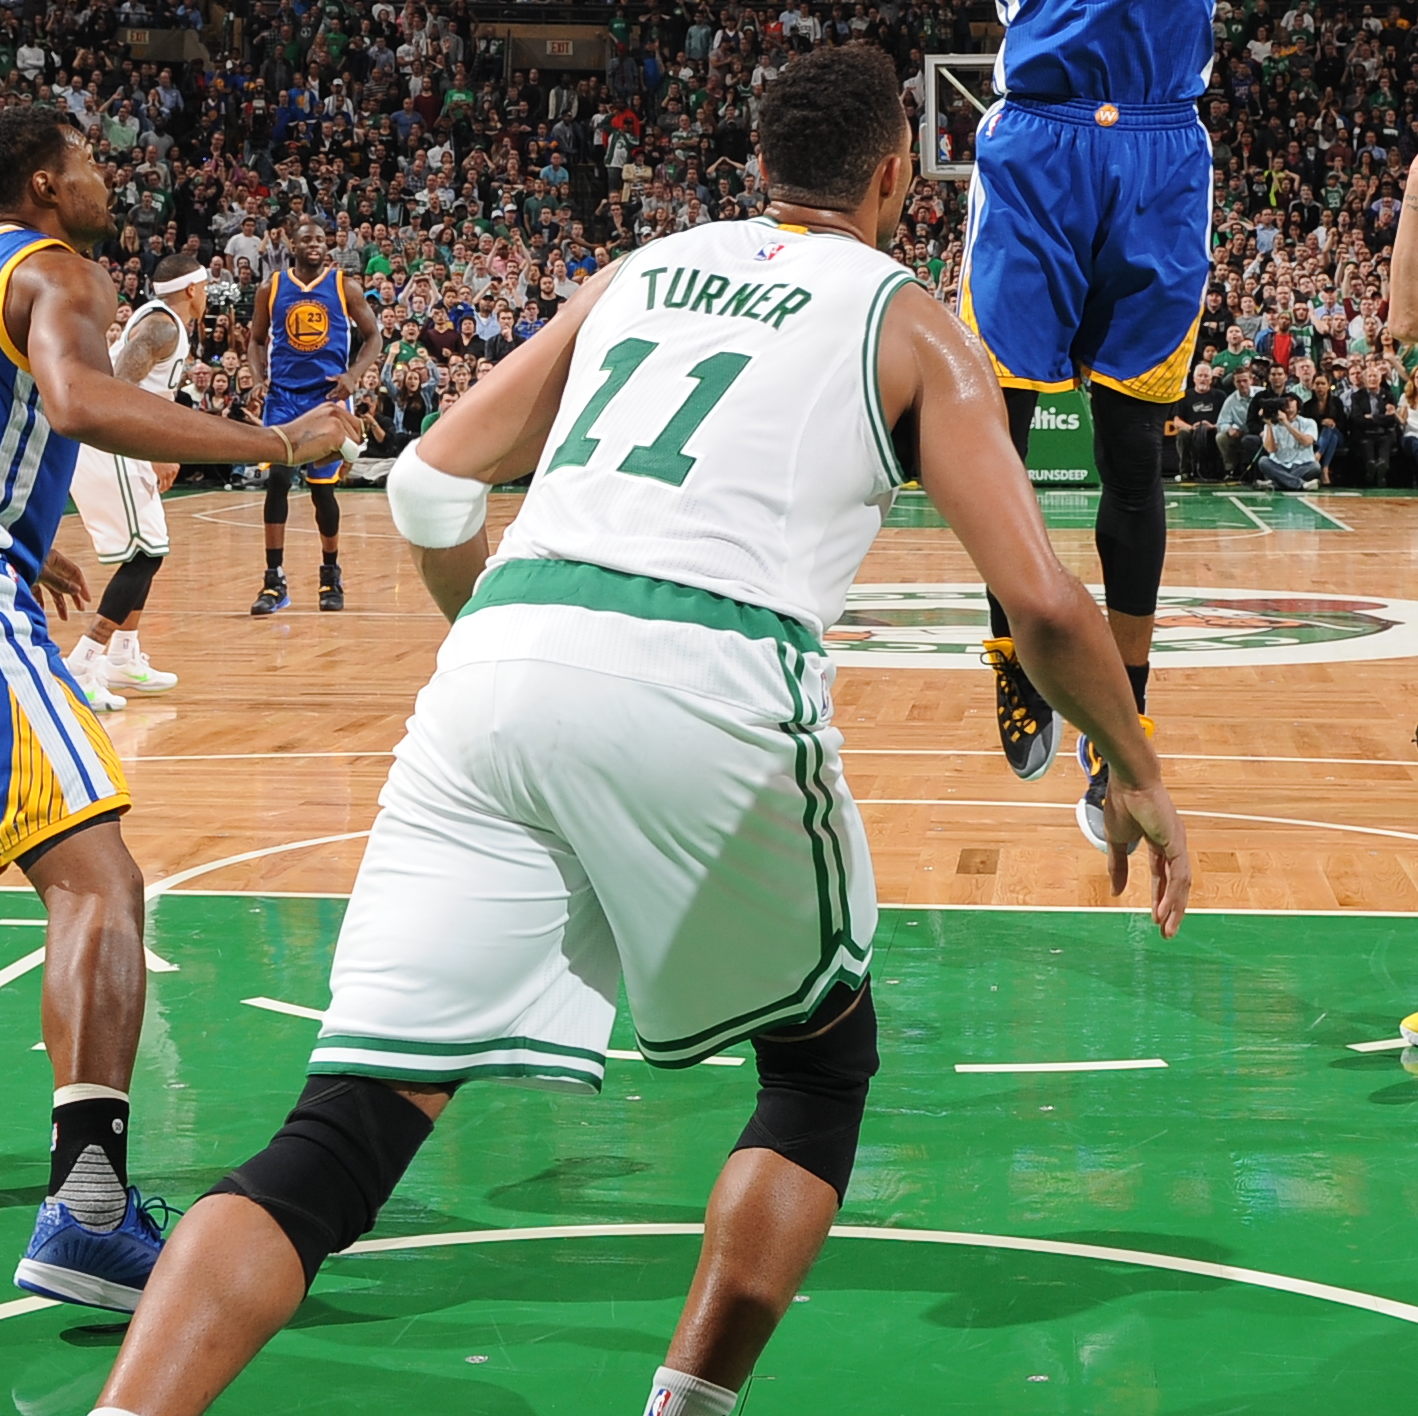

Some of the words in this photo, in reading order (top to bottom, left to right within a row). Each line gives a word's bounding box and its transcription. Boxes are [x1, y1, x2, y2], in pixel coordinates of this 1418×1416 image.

[131, 30, 149, 43] EXIT
[551, 41, 570, 54] EXIT
[640, 266, 813, 331] TURNER
[307, 312, 323, 323] 23
[543, 336, 754, 488] 11
[1028, 406, 1080, 430] eltics
[1027, 469, 1088, 481] RUNSDEEP
